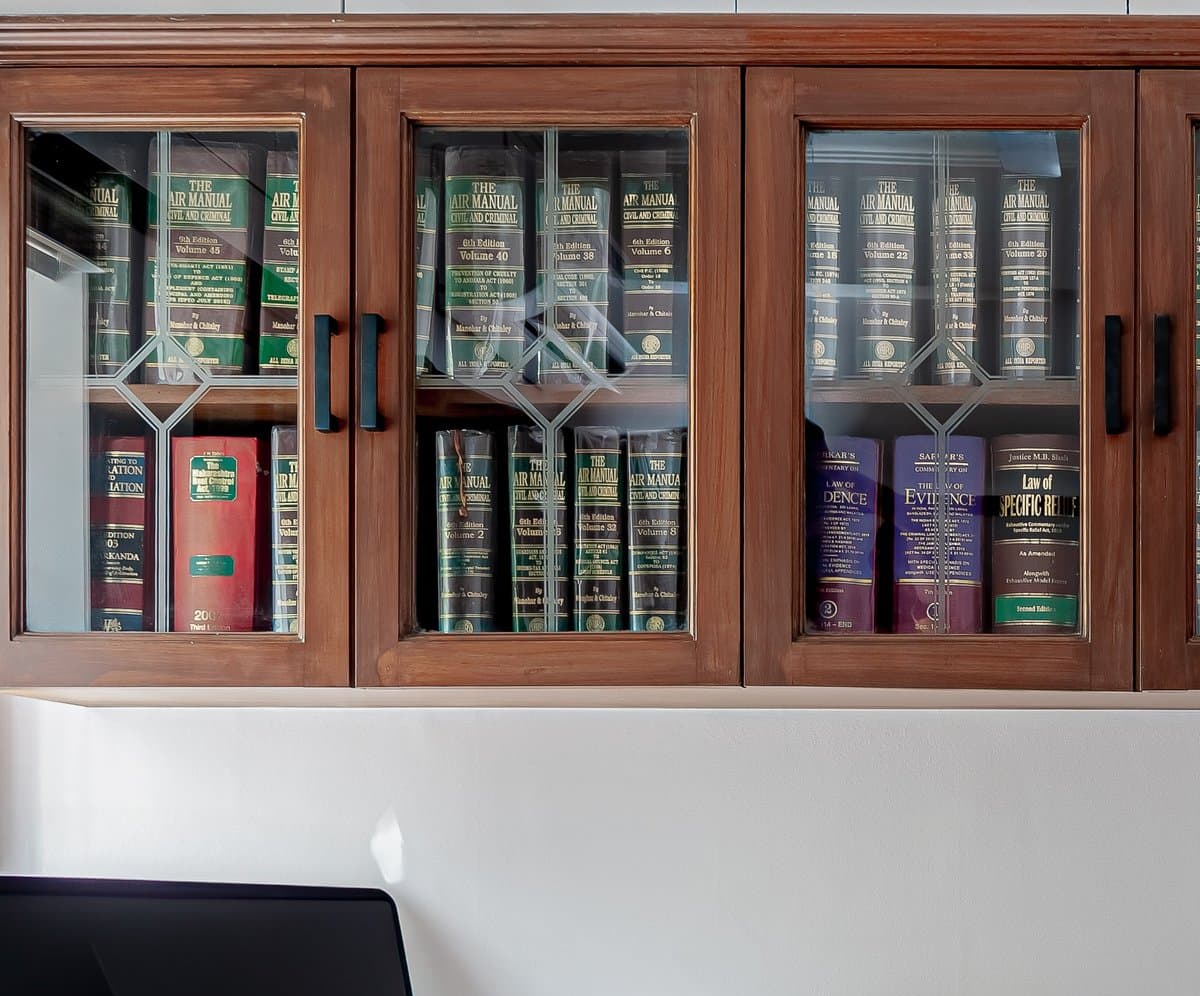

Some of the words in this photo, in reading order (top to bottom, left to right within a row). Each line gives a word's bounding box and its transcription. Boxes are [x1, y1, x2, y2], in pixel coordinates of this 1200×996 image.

[189, 181, 212, 191] THE
[472, 182, 496, 193] THE
[562, 184, 580, 195] THE
[643, 181, 659, 190] THE
[879, 182, 896, 193] THE
[1018, 180, 1035, 191] THE
[170, 192, 185, 206] AIR
[189, 193, 232, 208] MANUAL
[272, 192, 290, 207] AIR
[452, 195, 469, 208] AIR
[472, 195, 518, 209] MANUAL
[562, 196, 597, 210] MANUAL
[624, 194, 638, 206] AIR
[808, 197, 839, 210] MANUAL
[861, 195, 875, 209] AIR
[878, 195, 915, 211] MANUAL
[1004, 195, 1016, 208] AIR
[1018, 195, 1049, 208] MANUAL
[186, 211, 199, 220] AND
[201, 211, 231, 221] CRIMINAL
[272, 211, 288, 221] CIVIL
[470, 213, 483, 222] AND
[485, 213, 517, 223] CRIMINAL
[561, 215, 571, 224] AND
[572, 214, 597, 224] CRIMINAL
[875, 214, 886, 224] AND
[888, 215, 914, 226] CRIMINAL
[1017, 212, 1026, 221] AND
[1027, 212, 1049, 221] CRIMINAL
[463, 239, 475, 247] 6th
[478, 239, 504, 247] Edition
[460, 251, 493, 260] Volume
[496, 252, 508, 261] 40
[583, 252, 594, 260] 38
[664, 247, 671, 255] 6
[591, 456, 605, 467] THE
[1009, 454, 1031, 462] Justice
[649, 460, 665, 470] THE
[514, 472, 528, 486] AIR
[578, 468, 589, 482] AIR
[591, 468, 618, 482] MANUAL
[631, 474, 645, 485] AIR
[1023, 474, 1040, 489] Law
[1043, 474, 1052, 489] of
[1000, 495, 1041, 516] SPECIFIC
